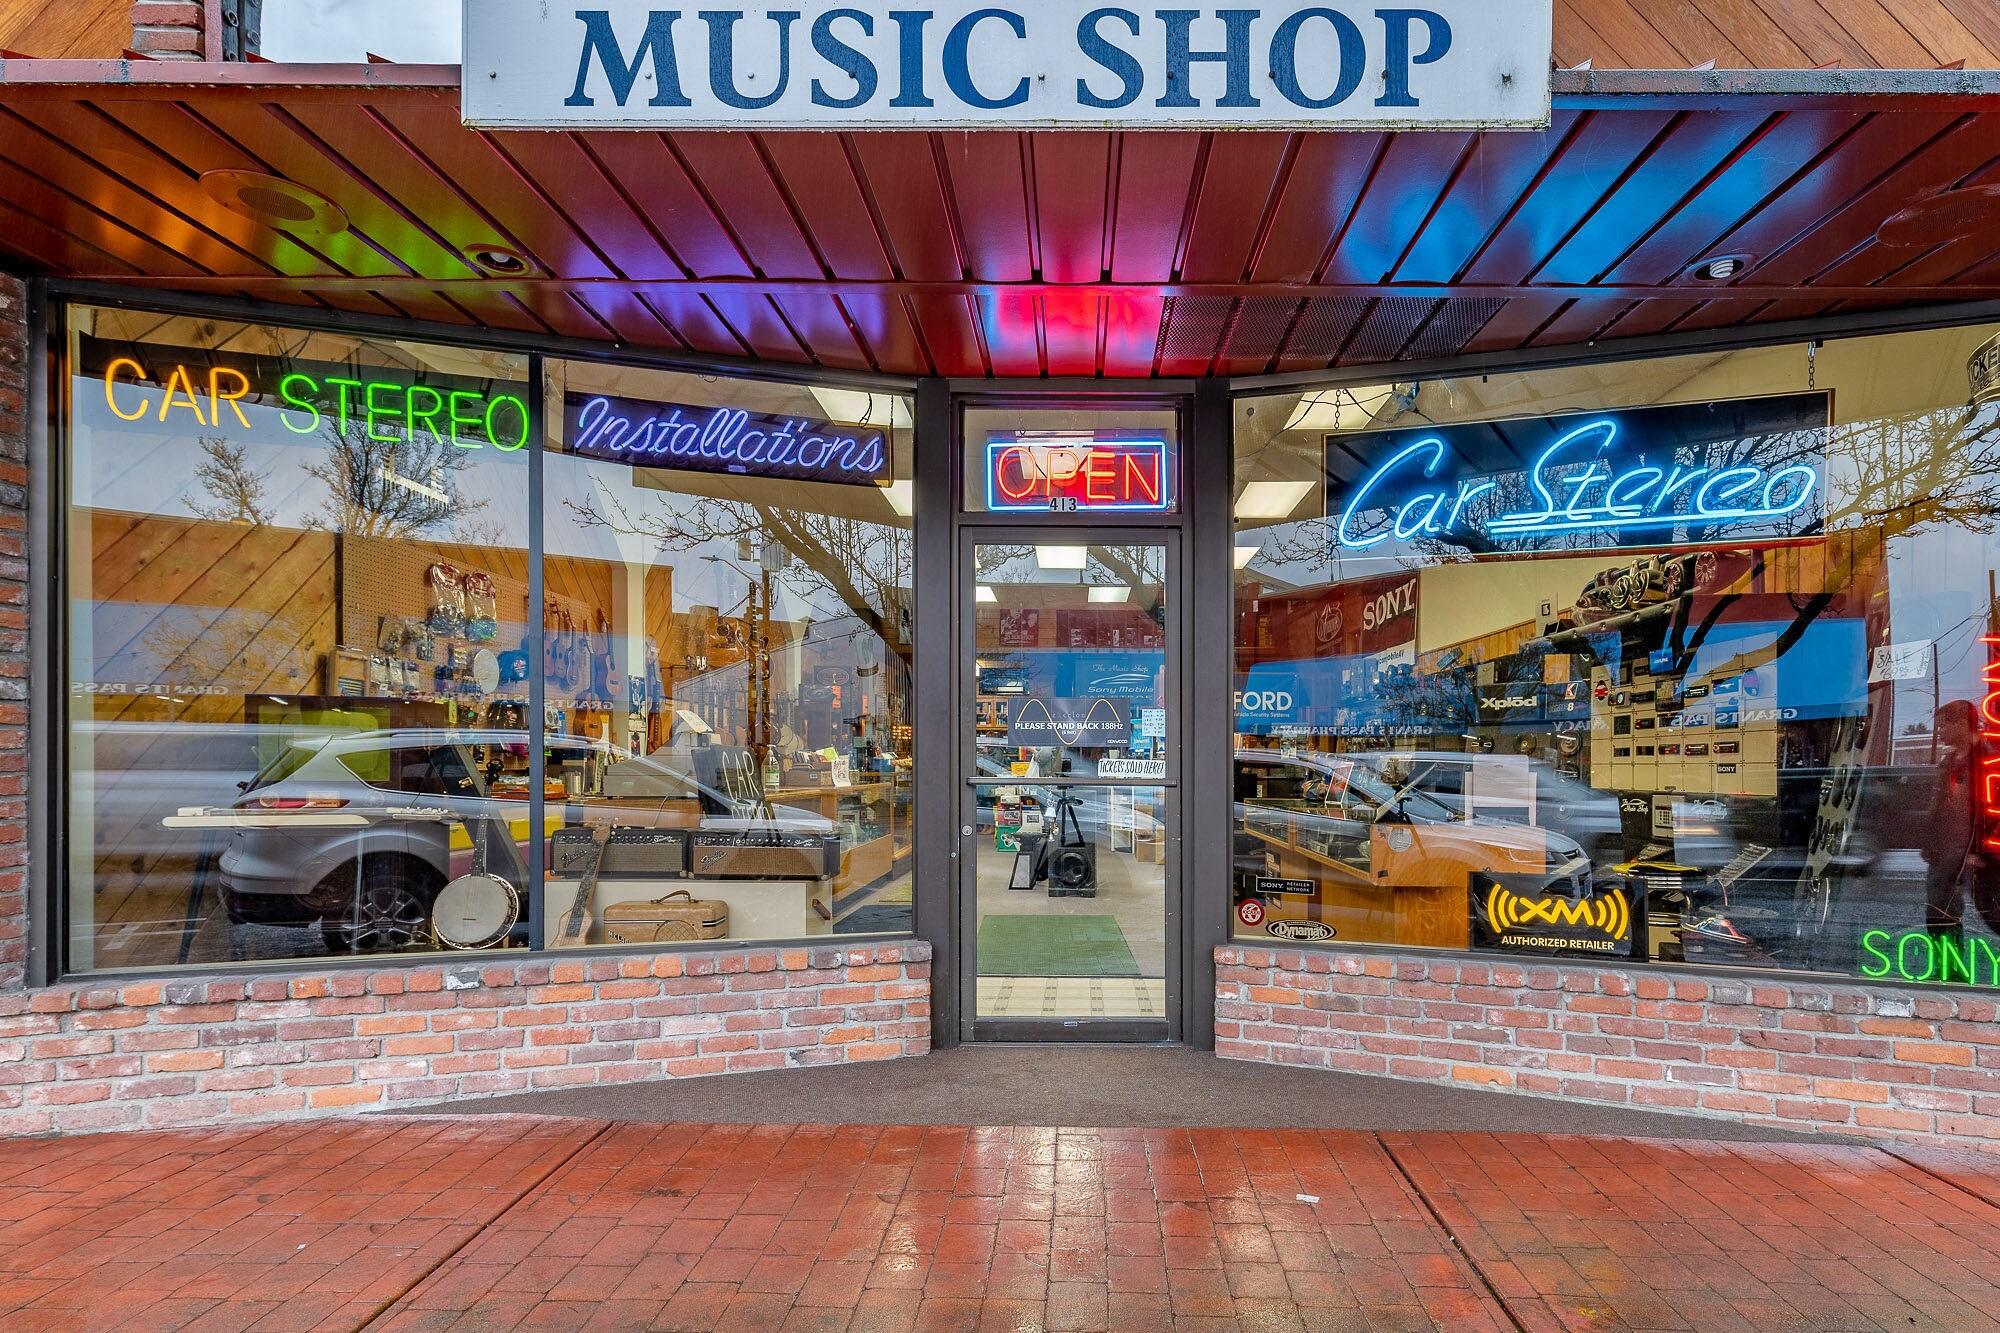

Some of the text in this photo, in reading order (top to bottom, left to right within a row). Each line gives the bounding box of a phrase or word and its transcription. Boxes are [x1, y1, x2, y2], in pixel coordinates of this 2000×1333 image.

[564, 8, 1451, 109] MUSIC SHOP
[105, 358, 530, 452] CAR STEREO
[574, 396, 885, 474] Installations
[998, 446, 1160, 502] OPEN
[1338, 420, 1817, 548] Car Stereo
[1050, 497, 1077, 512] 413
[1363, 578, 1416, 631] SONY
[1876, 647, 1912, 668] SALE
[1088, 686, 1117, 694] Sony
[1233, 691, 1293, 711] FORD
[1014, 722, 1124, 730] PLEASE STAND BACK 188Hz
[722, 750, 760, 802] CAR
[1099, 760, 1165, 774] TICKETS SOLD HERE!
[1260, 881, 1284, 889] SONY
[1279, 923, 1324, 937] Dynamat
[1501, 935, 1615, 951] AUTHORIZED RETAILER
[1862, 929, 2000, 987] SONY
